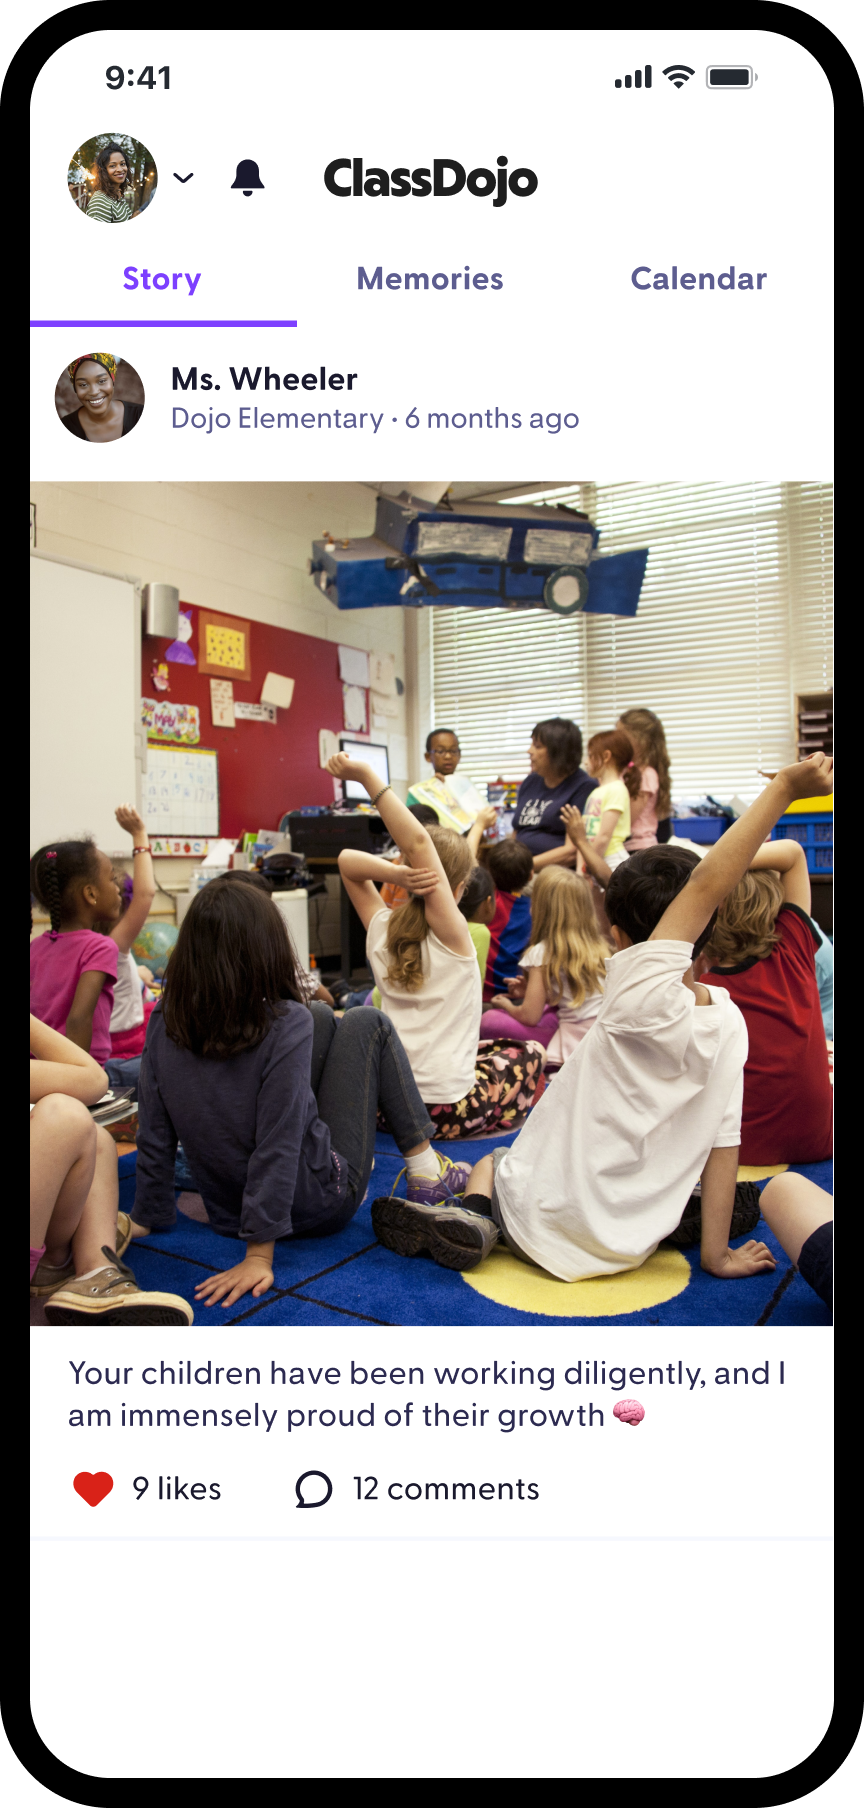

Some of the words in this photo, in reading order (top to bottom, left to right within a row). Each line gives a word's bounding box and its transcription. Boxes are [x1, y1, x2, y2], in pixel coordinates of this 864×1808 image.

[105, 65, 171, 91] 9:41
[323, 155, 539, 208] ClassDojo
[123, 265, 202, 296] Story
[357, 265, 504, 291] Memories
[631, 265, 768, 291] Calendar
[172, 366, 221, 391] Ms.
[228, 366, 358, 391] Wheeler
[172, 406, 231, 435] Dojo
[239, 406, 384, 434] Elementary
[405, 406, 420, 429] 6
[427, 406, 523, 429] months
[529, 412, 580, 435] ago
[68, 1360, 134, 1385] Your
[141, 1360, 261, 1385] children
[270, 1360, 342, 1385] have
[350, 1360, 424, 1385] been
[433, 1360, 555, 1392] working
[564, 1360, 706, 1392] diligently,
[714, 1360, 770, 1385] and
[779, 1360, 785, 1385] I
[68, 1409, 111, 1427] am
[121, 1402, 278, 1433] immensely
[287, 1402, 375, 1433] proud
[384, 1401, 414, 1427] of
[422, 1402, 490, 1427] their
[497, 1402, 604, 1434] growth
[132, 1475, 150, 1501] 9
[158, 1475, 222, 1501] likes
[353, 1475, 379, 1500] 12
[387, 1478, 540, 1501] comments
